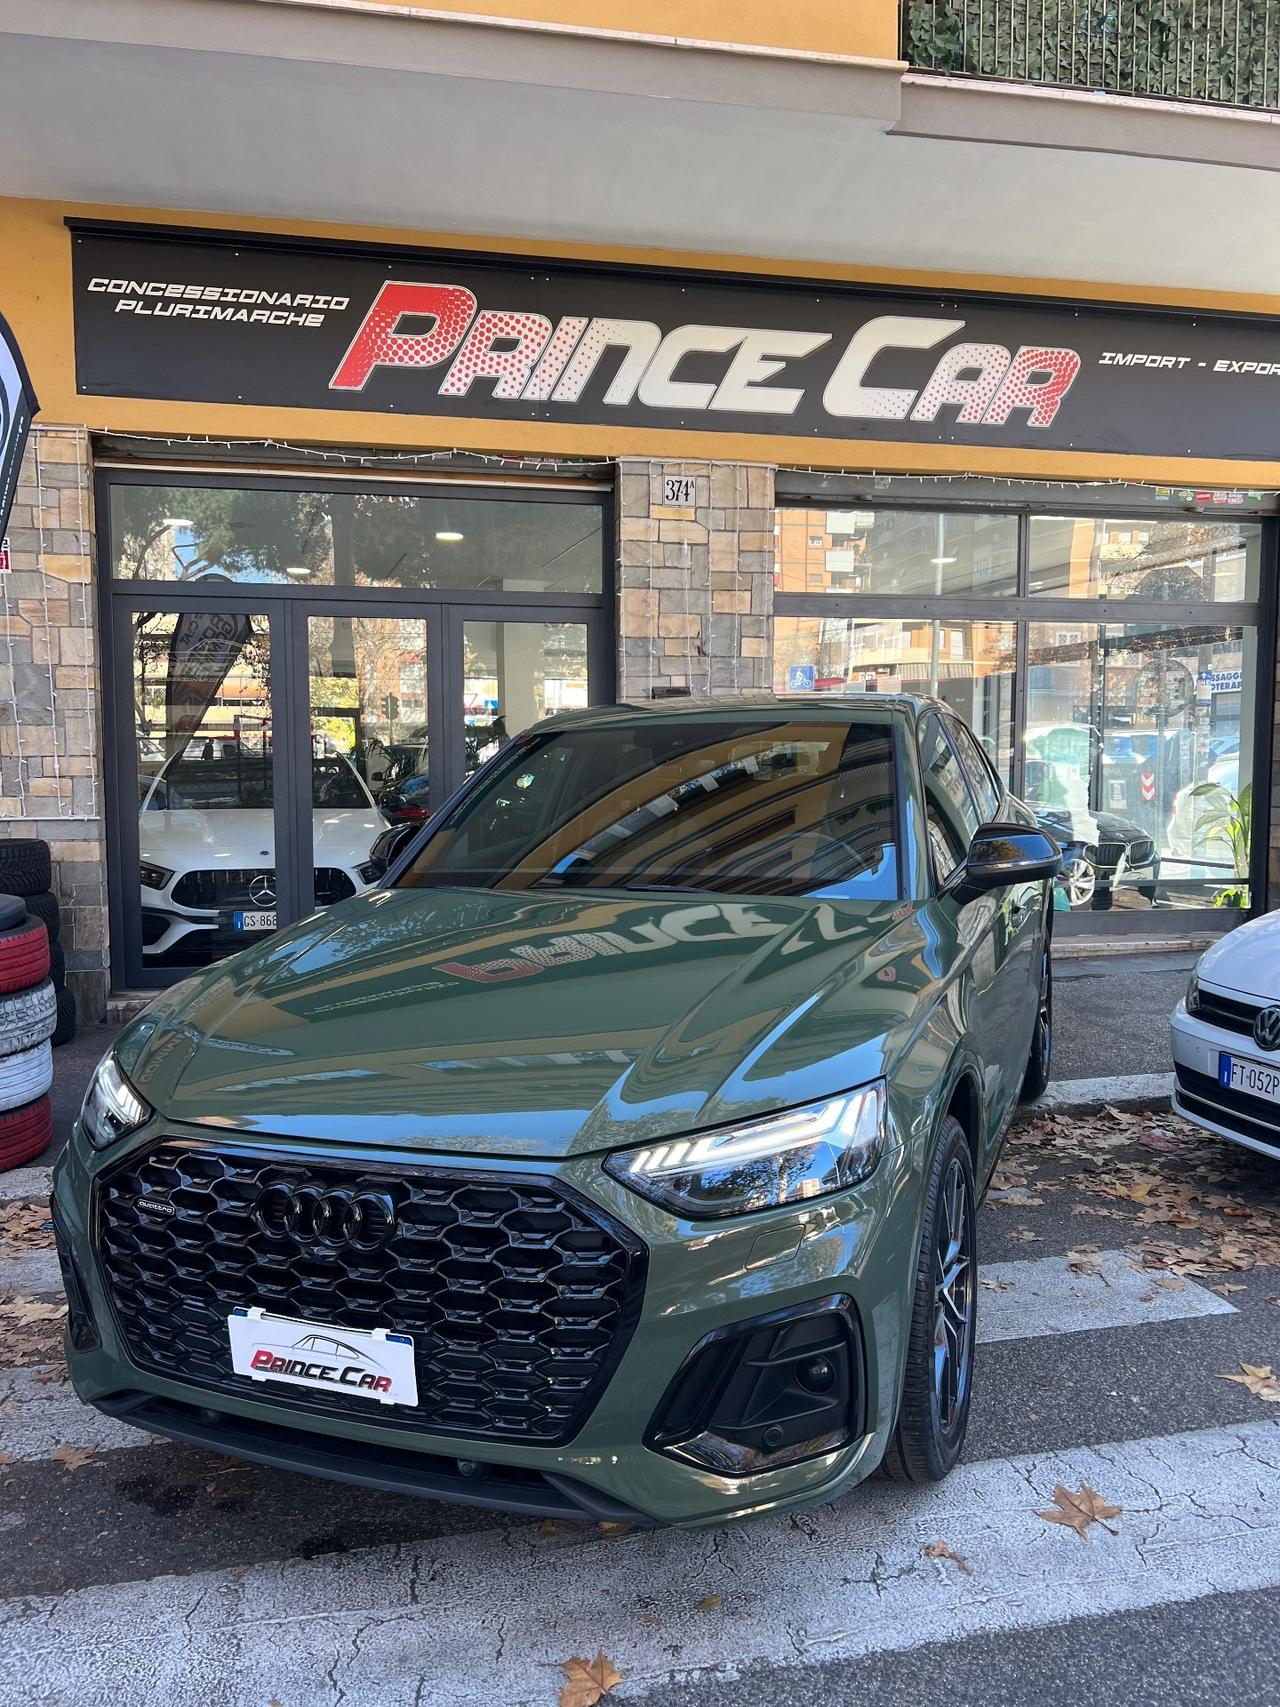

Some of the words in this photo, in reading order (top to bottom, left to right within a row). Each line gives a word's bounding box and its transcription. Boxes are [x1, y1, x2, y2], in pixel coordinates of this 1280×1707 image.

[88, 278, 350, 310] CONCESSIONARIO
[115, 299, 325, 328] PLURIMARCHE
[329, 279, 833, 414] PRINCE
[823, 315, 1081, 428] CAR
[1099, 352, 1191, 369] IMPORT
